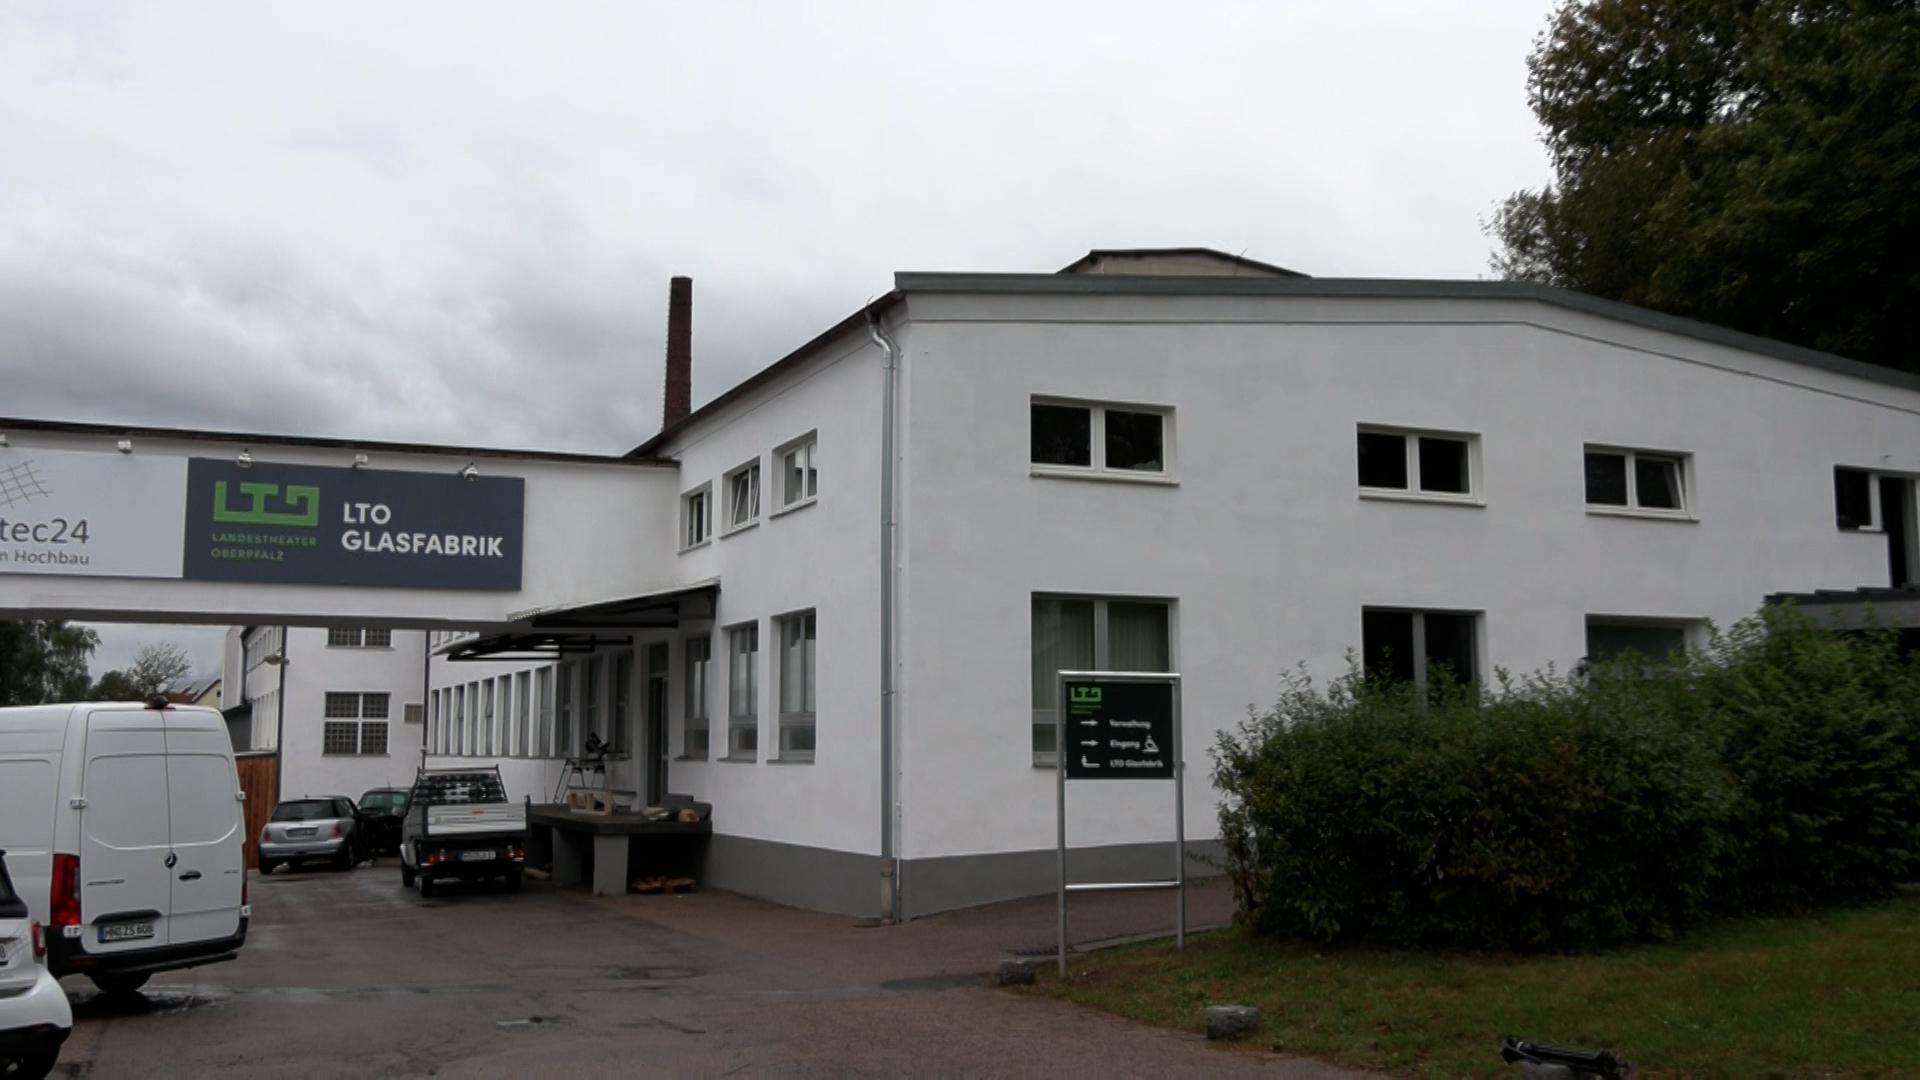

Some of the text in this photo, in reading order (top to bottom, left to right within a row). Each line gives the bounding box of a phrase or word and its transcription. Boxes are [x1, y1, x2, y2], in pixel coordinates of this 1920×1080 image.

[343, 501, 392, 525] LTO
[211, 532, 318, 547] LANDESTHEATER
[341, 529, 504, 558] GLASFABRIK
[14, 549, 90, 566] Hochbau
[210, 547, 285, 561] OBERPFALZ
